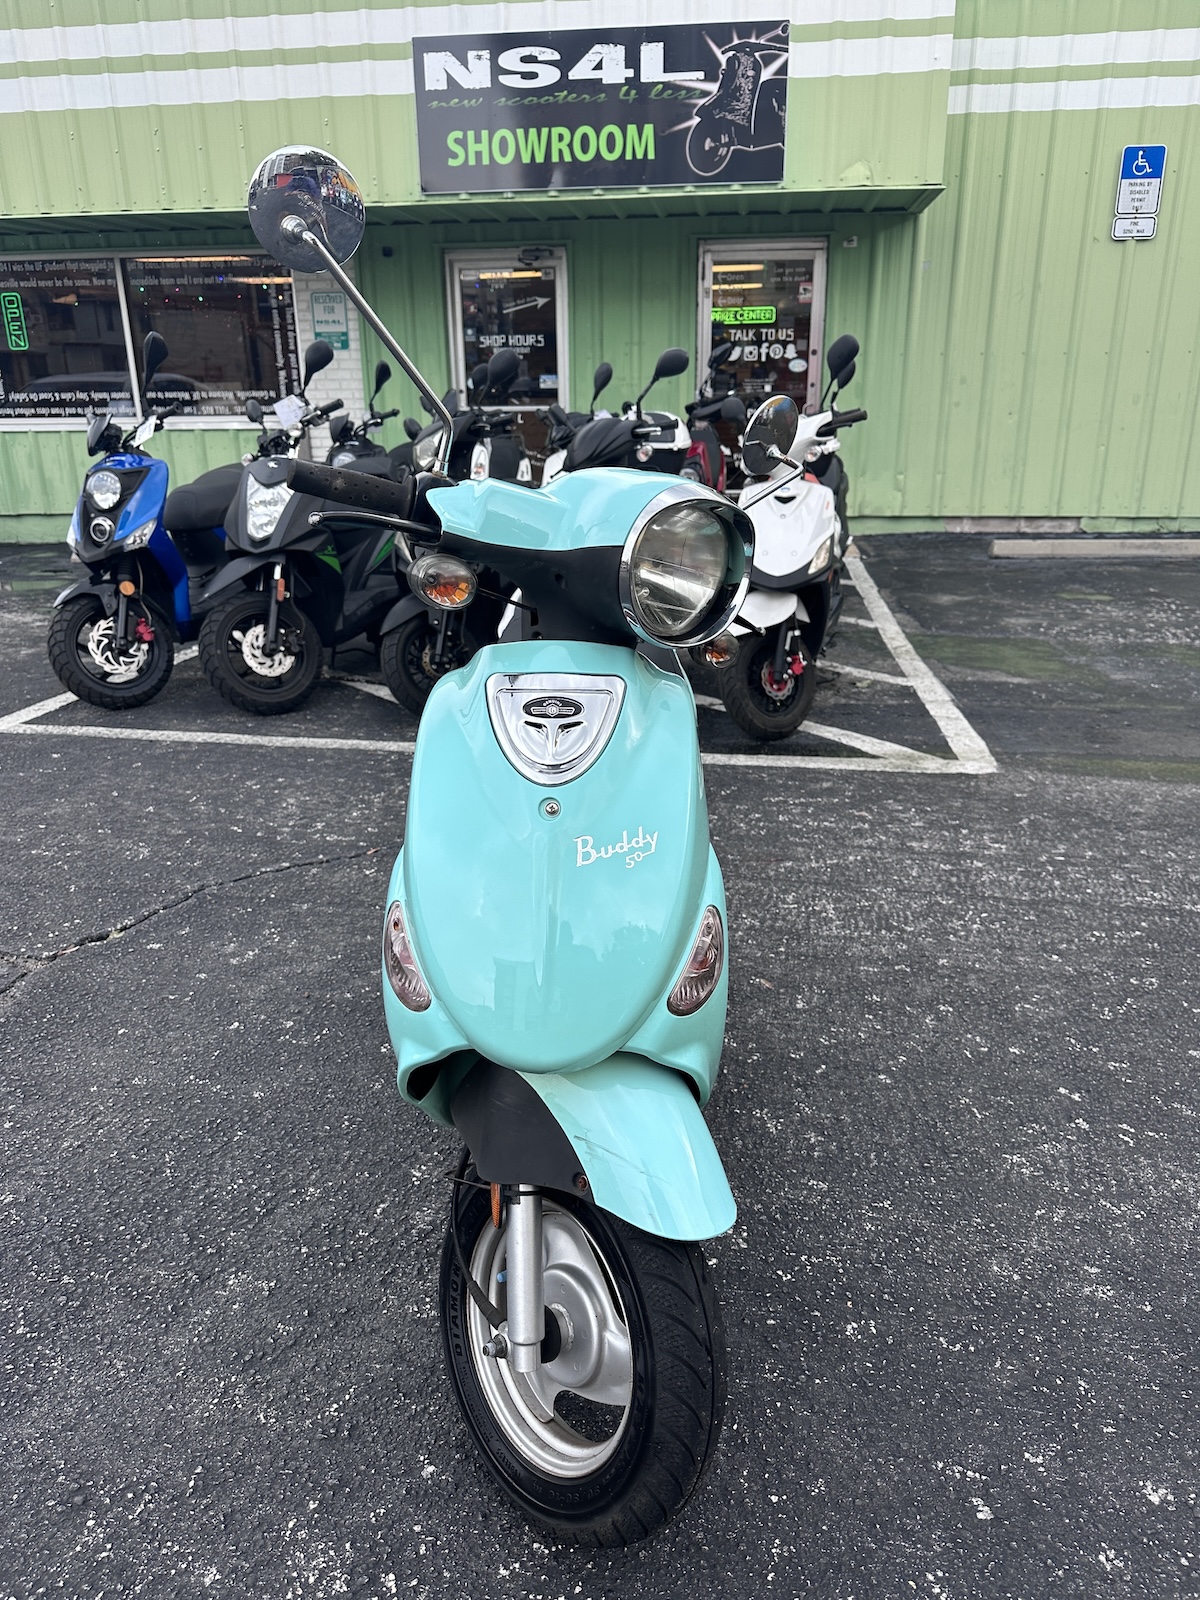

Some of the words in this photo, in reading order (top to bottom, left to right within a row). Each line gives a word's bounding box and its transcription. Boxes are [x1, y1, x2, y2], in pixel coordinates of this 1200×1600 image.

[423, 42, 705, 91] NS4L
[428, 94, 483, 109] new
[497, 90, 606, 107] scooters
[618, 86, 637, 104] 4
[652, 82, 704, 101] less
[446, 124, 656, 166] SHOWROOM
[314, 294, 342, 304] RESERVED
[324, 305, 335, 314] FOR
[5, 294, 26, 347] OPEN
[736, 310, 772, 320] CENTER
[479, 335, 506, 348] SHOP
[508, 334, 544, 347] HOURS
[728, 329, 756, 341] TALK
[760, 328, 776, 340] TO
[778, 328, 794, 340] US
[572, 826, 658, 867] Buddy
[626, 852, 643, 868] 50
[450, 1262, 464, 1357] DIAMON
